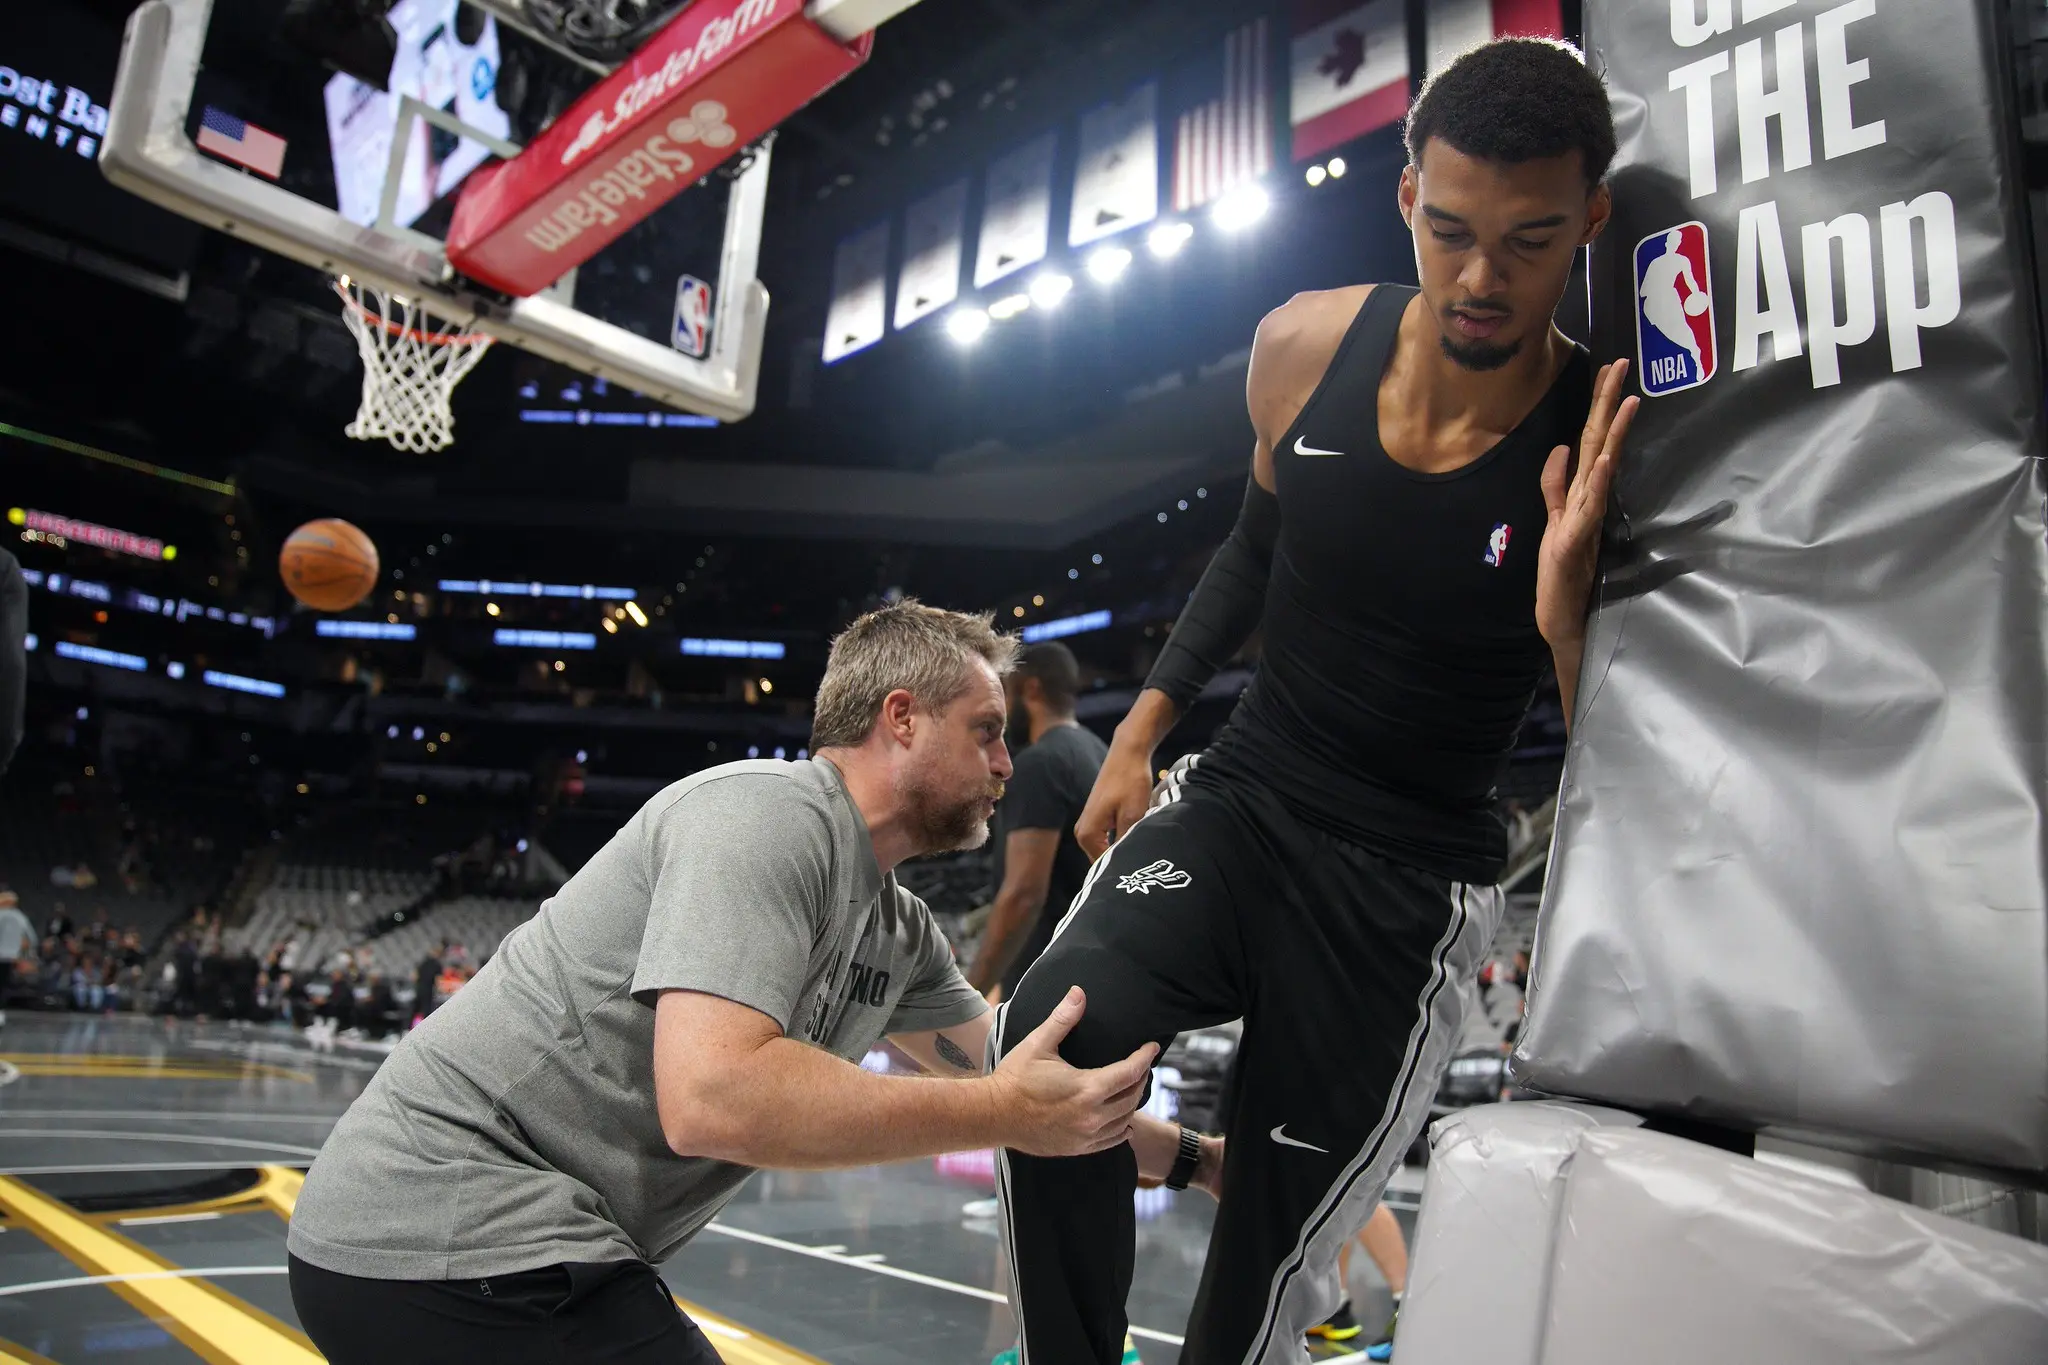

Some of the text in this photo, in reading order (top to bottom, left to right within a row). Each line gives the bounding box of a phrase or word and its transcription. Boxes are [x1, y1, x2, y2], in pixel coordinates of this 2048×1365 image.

[1668, 0, 1887, 200] THE
[1651, 353, 1688, 386] NBA
[1732, 190, 1961, 389] App
